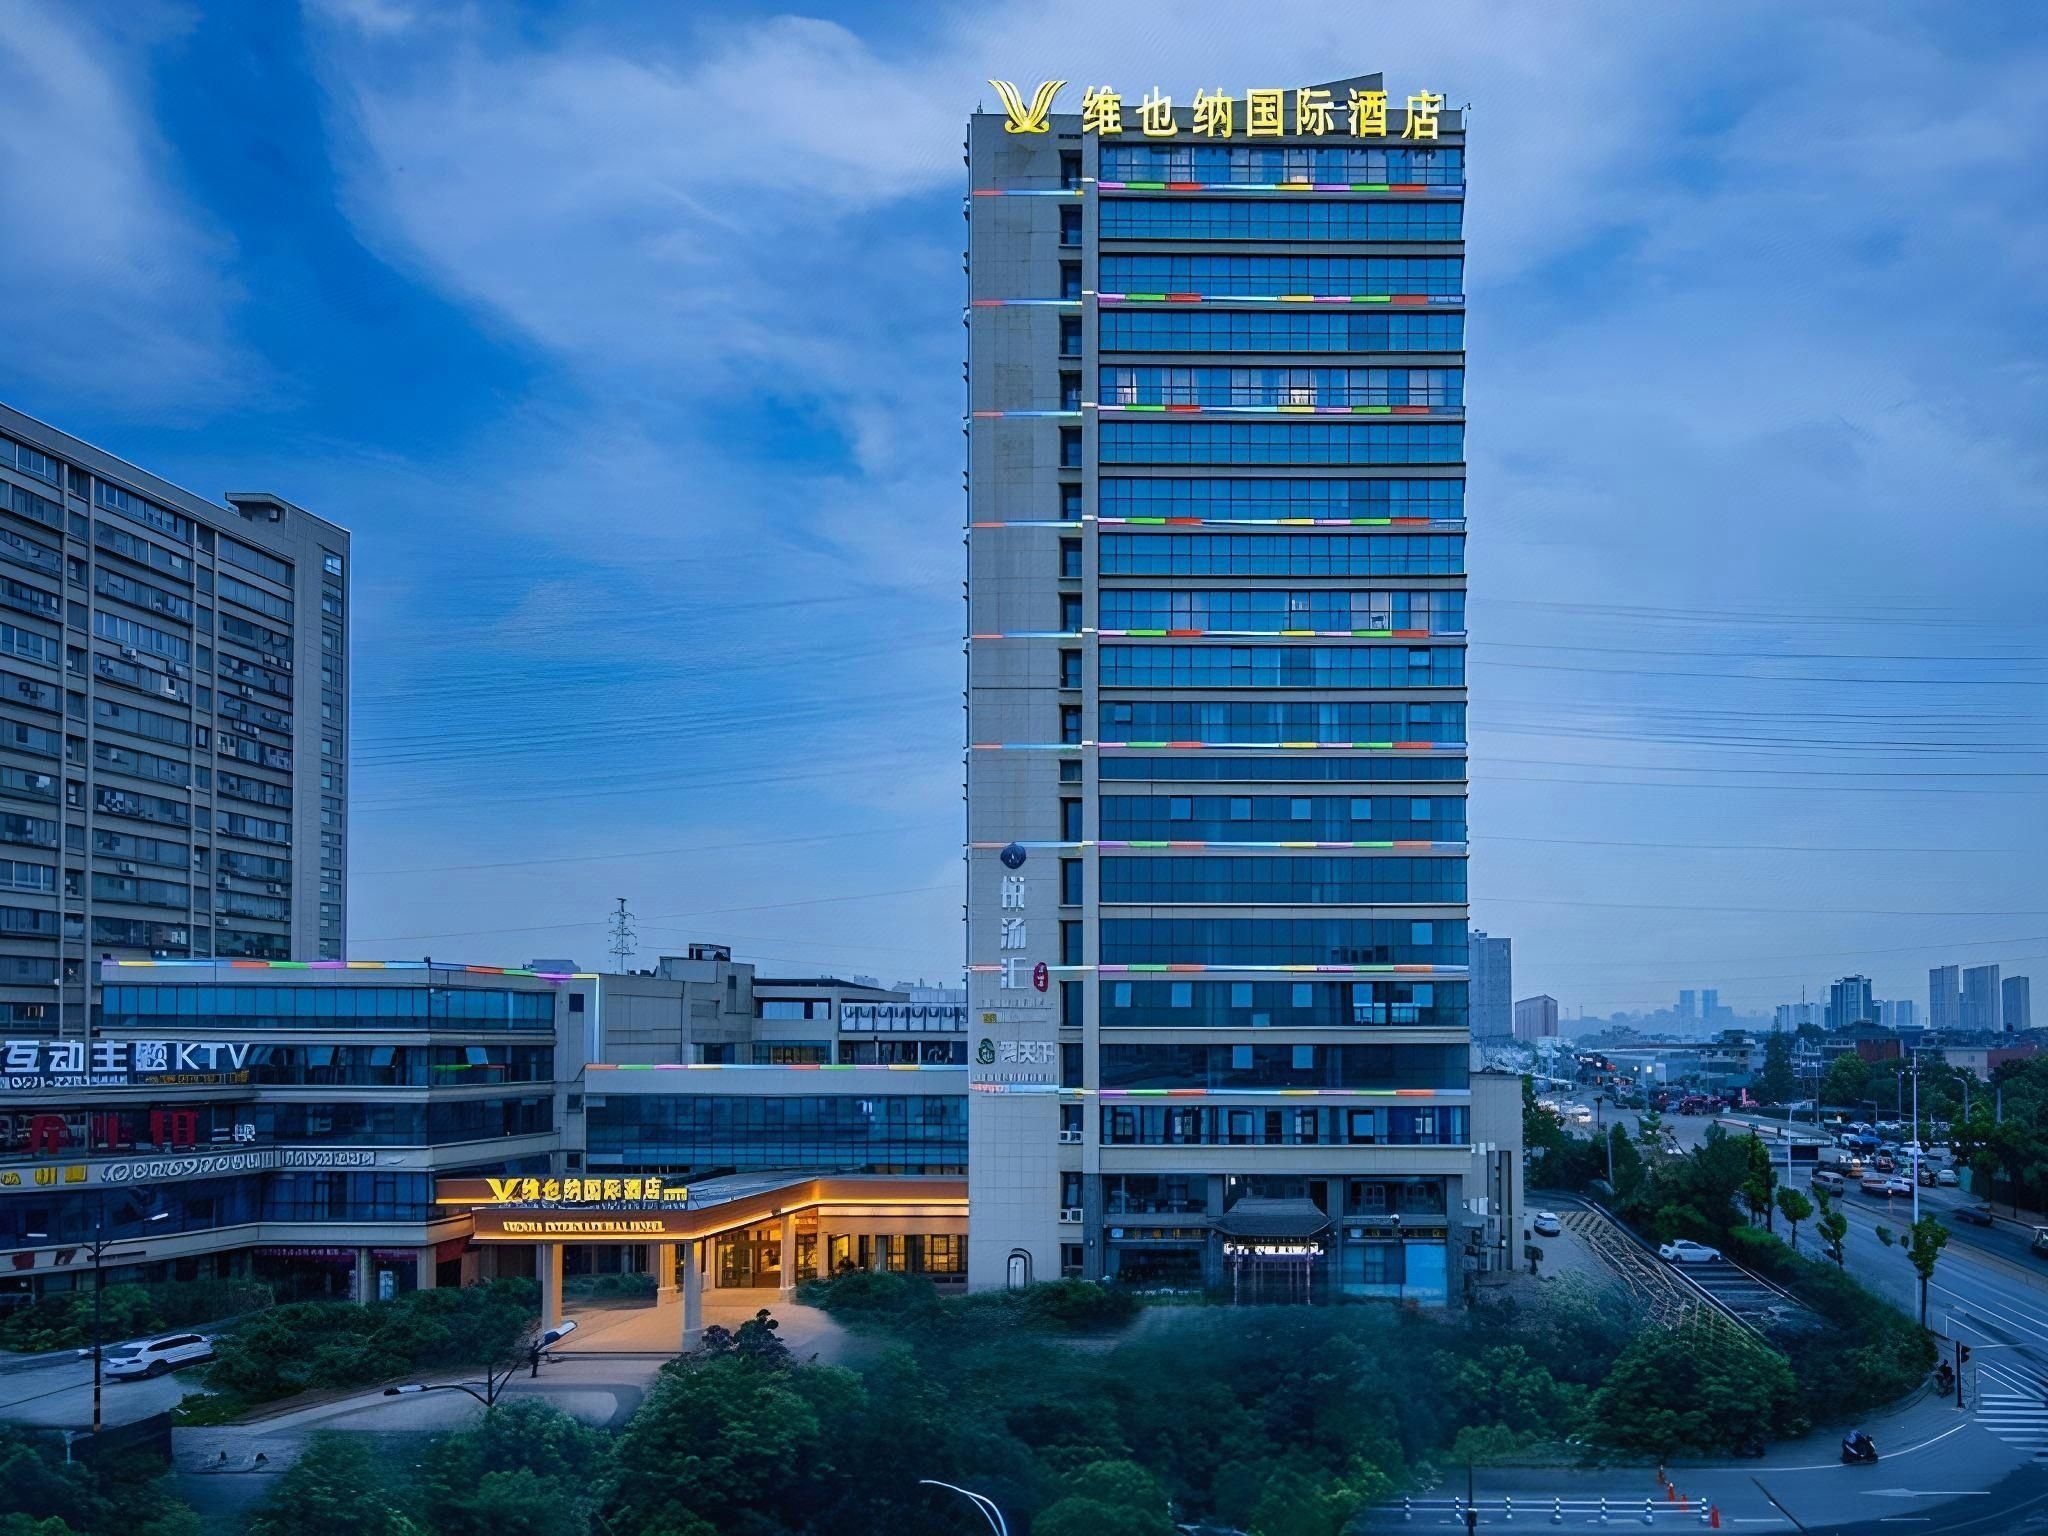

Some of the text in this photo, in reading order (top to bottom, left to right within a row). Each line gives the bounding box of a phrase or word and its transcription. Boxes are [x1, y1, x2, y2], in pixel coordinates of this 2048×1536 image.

[1082, 86, 1443, 140] 维也纳国际酒店
